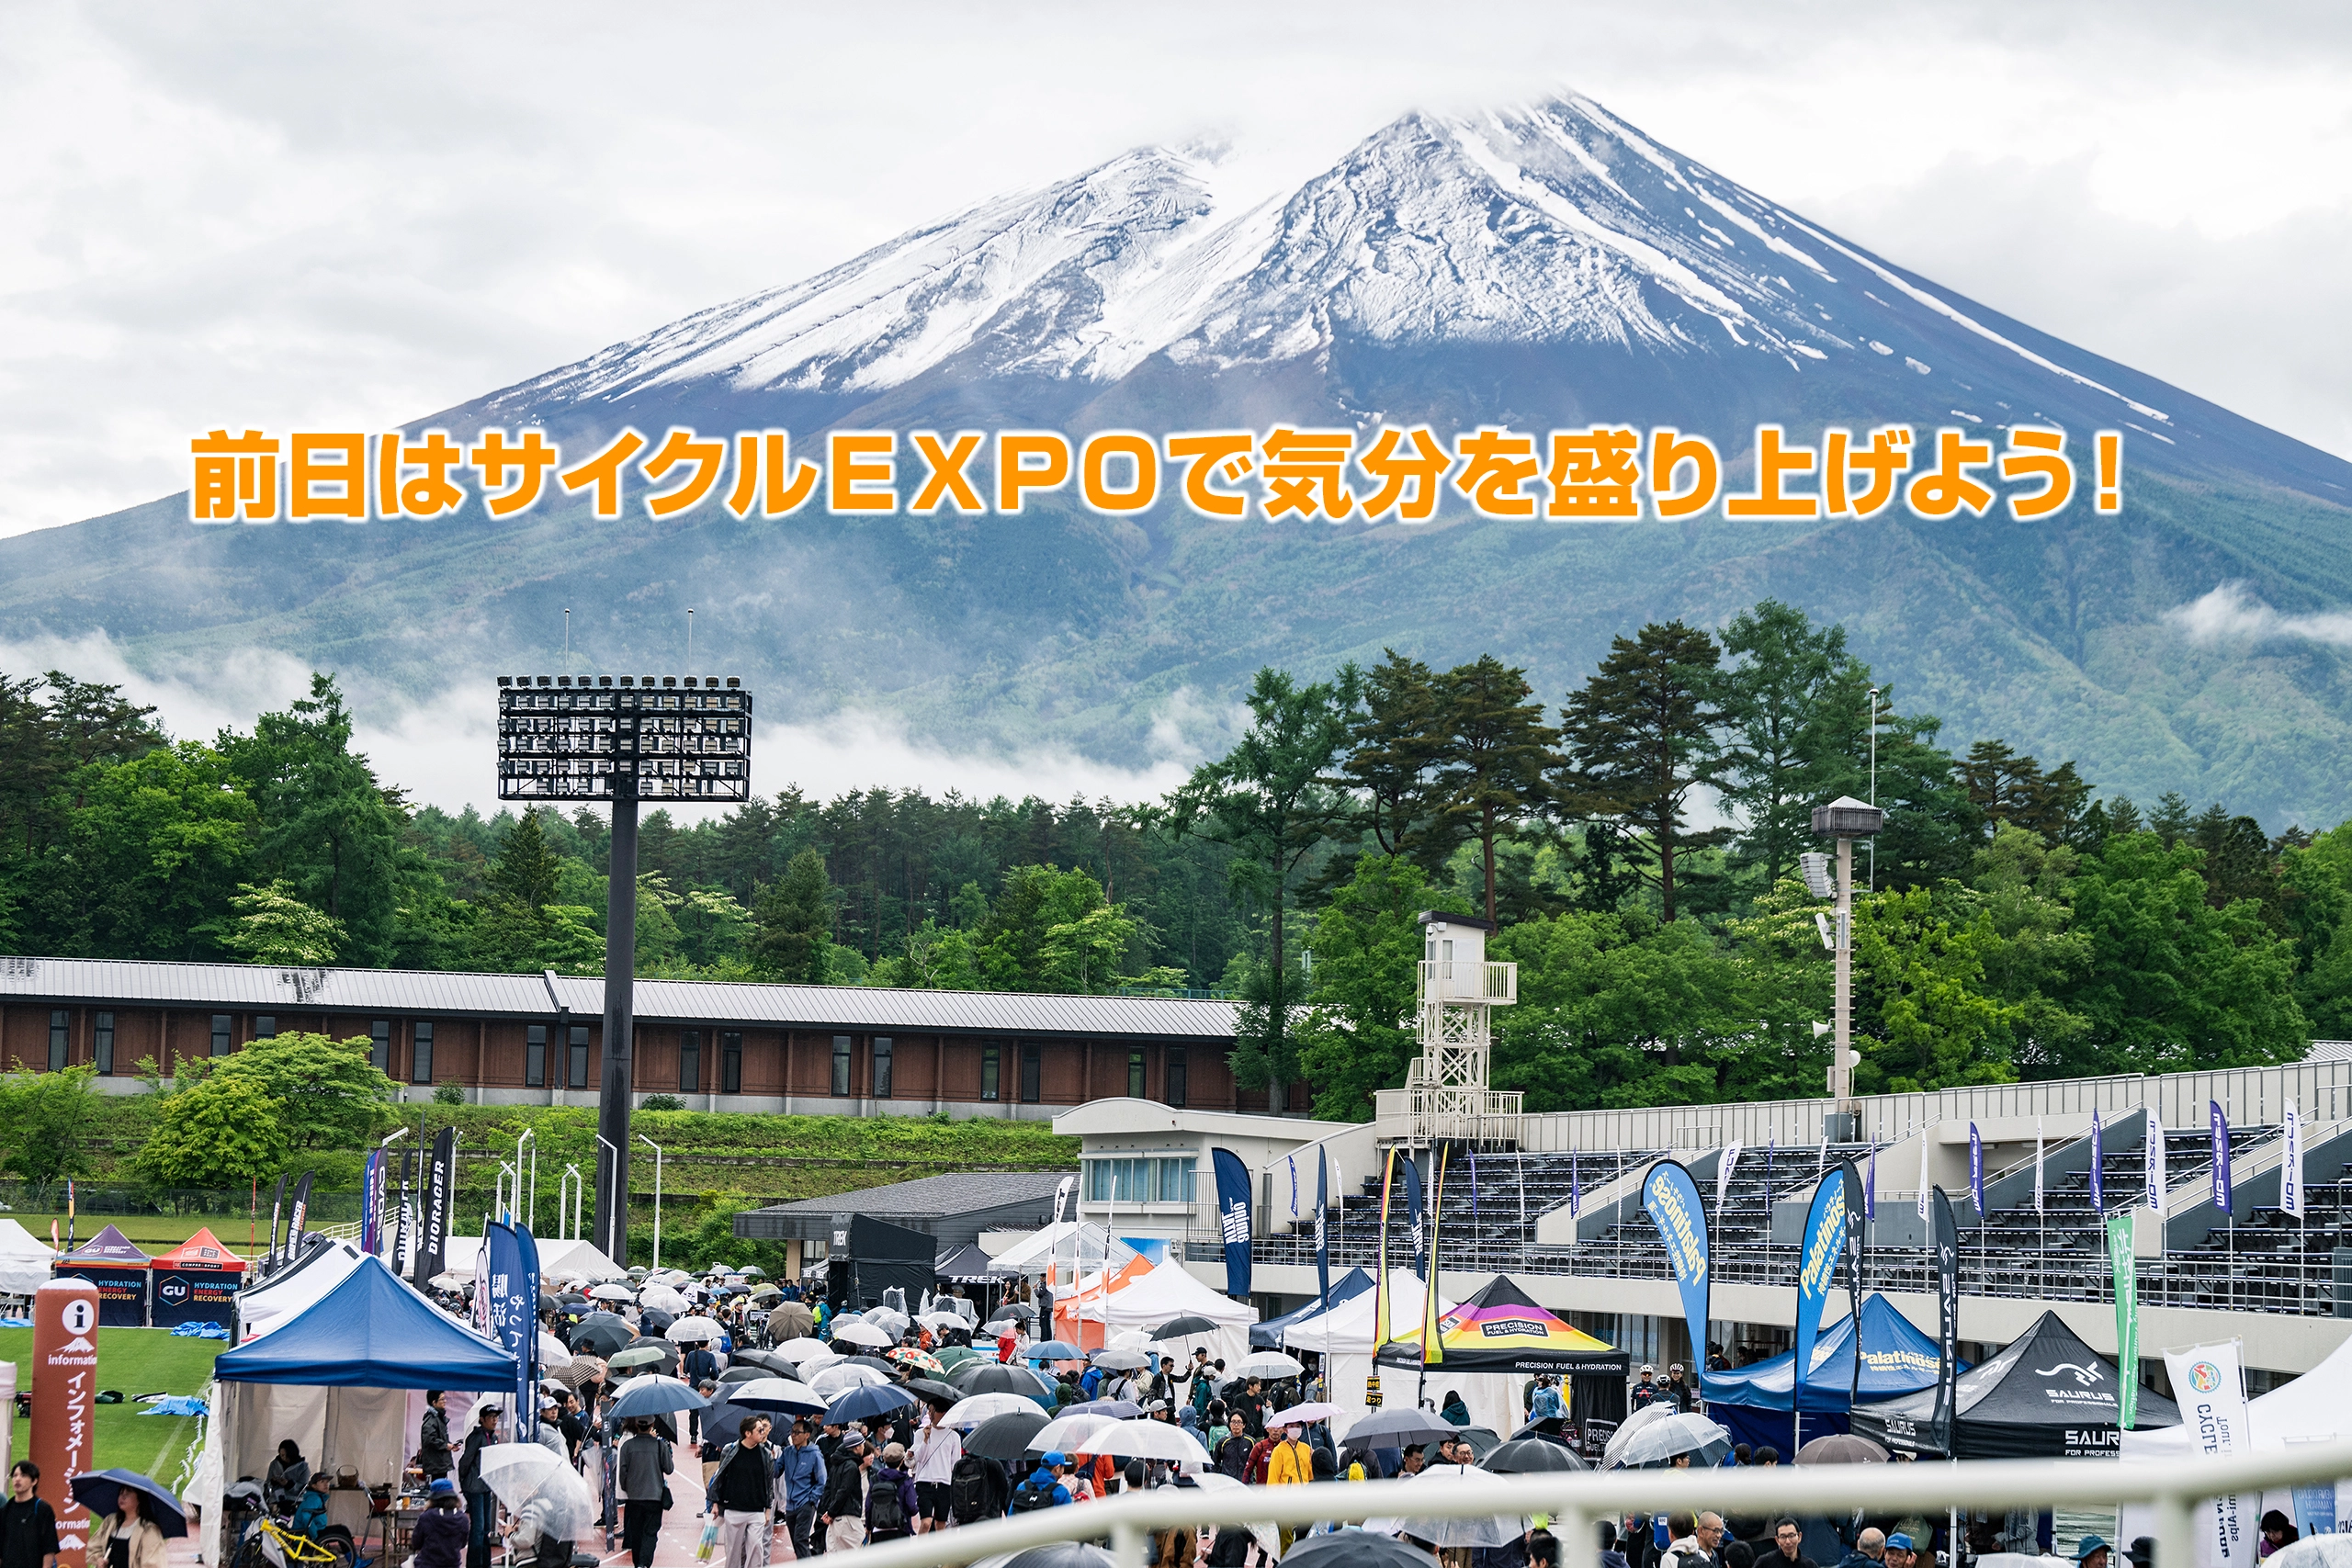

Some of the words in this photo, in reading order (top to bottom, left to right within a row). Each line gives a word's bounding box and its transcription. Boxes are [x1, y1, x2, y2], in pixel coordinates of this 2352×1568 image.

[428, 1160, 445, 1256] BIORACER
[832, 1230, 847, 1247] TREK
[1800, 1191, 1847, 1300] Palatinos
[98, 1280, 141, 1288] HYDRATION
[948, 1275, 1006, 1284] TREK
[163, 1285, 186, 1297] GU
[1486, 1322, 1544, 1331] PRECISION
[1510, 1327, 1544, 1336] HYDRATION
[1515, 1361, 1554, 1370] PRECISION
[2045, 1389, 2115, 1402] SAURUS
[63, 1371, 87, 1514] インフォメーシン
[2064, 1430, 2120, 1446] SAUR
